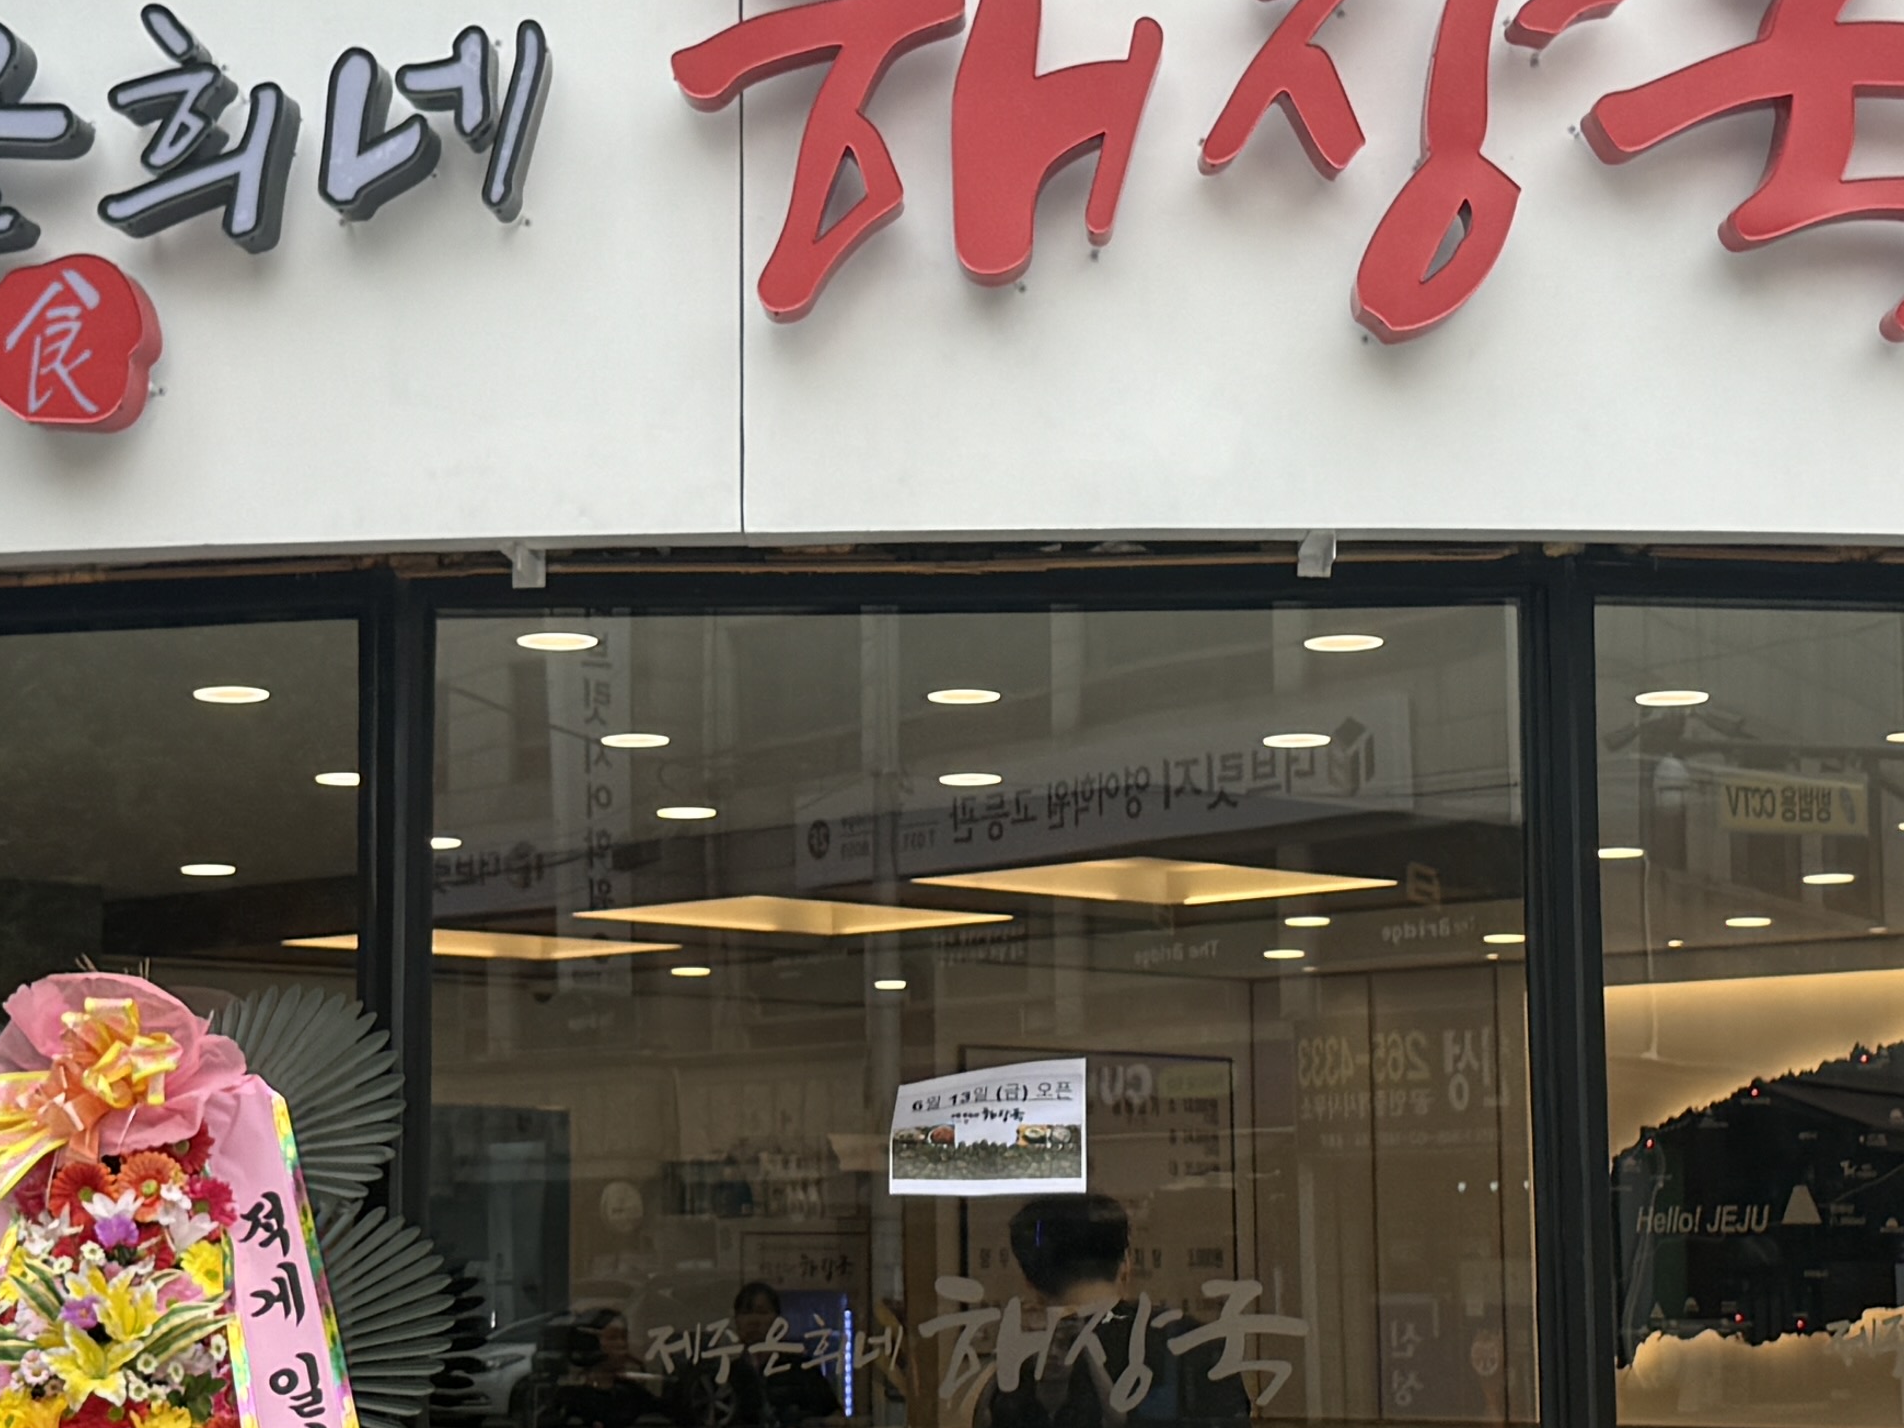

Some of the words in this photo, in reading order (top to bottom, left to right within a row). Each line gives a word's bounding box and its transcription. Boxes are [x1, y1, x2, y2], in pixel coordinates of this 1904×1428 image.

[2, 269, 99, 417] 食
[911, 1094, 942, 1113] 6월
[949, 1085, 989, 1107] 13일
[996, 1081, 1029, 1103] (금)
[1035, 1080, 1074, 1102] 오픈
[237, 1189, 310, 1328] 적게
[1636, 1204, 1704, 1235] Hello!
[1705, 1204, 1772, 1235] JEJU
[644, 1312, 905, 1386] 제주은희네
[918, 1278, 1310, 1413] 해장국
